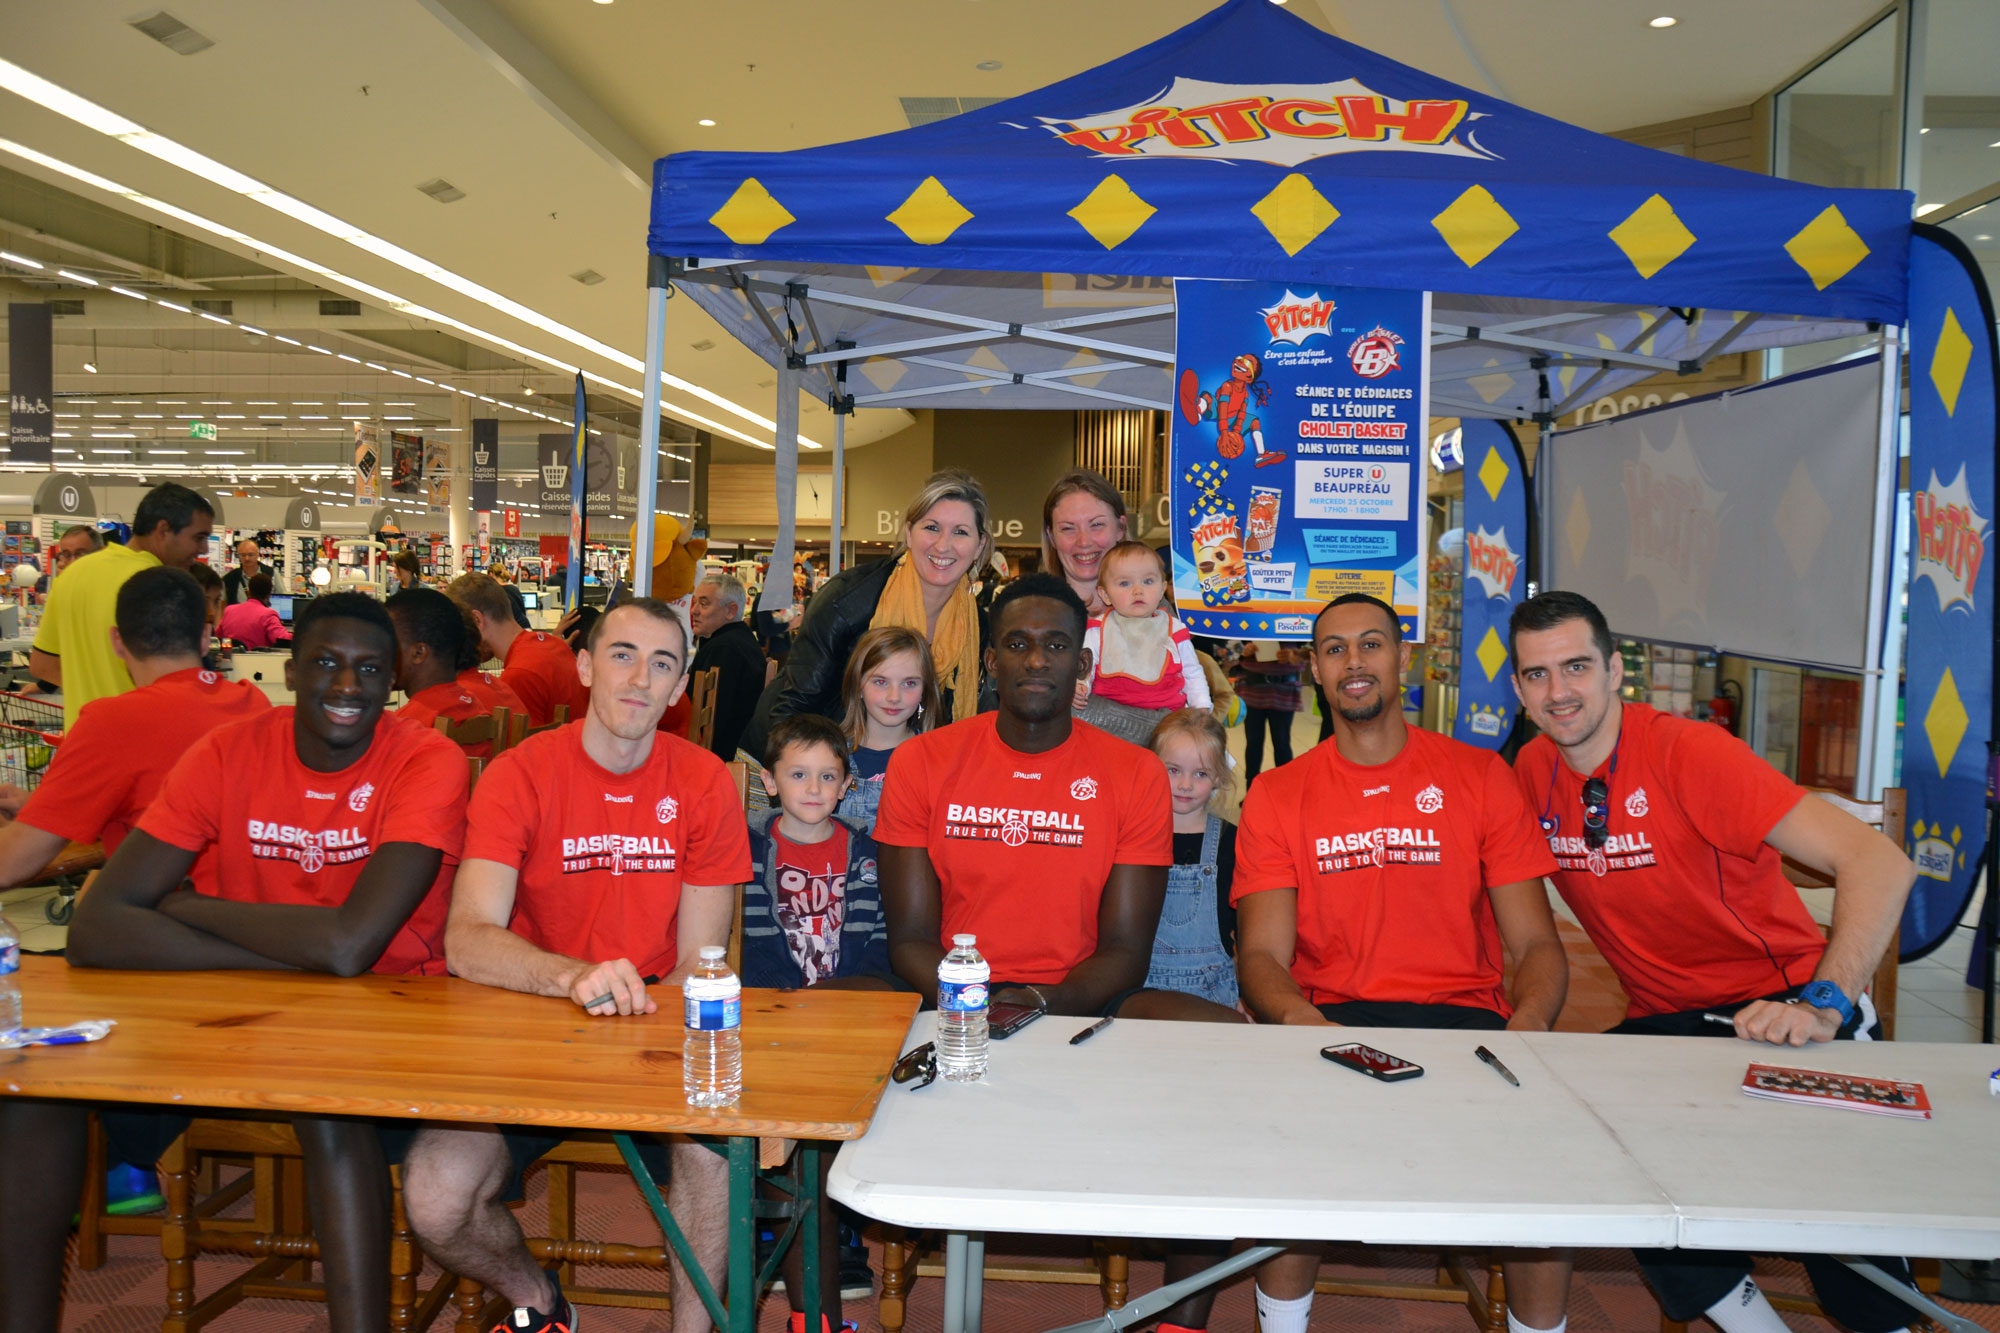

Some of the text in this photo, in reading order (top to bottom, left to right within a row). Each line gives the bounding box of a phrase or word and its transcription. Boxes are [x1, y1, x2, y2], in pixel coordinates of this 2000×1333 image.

[1297, 348, 1326, 358] enfant
[1278, 356, 1333, 366] c'est du sport
[1296, 384, 1412, 399] SÉANCE DE DÉDICACES
[1311, 401, 1396, 418] DE L'ÉQUIPE
[12, 426, 34, 434] Caisse
[1300, 422, 1406, 438] CHOLET BASKET
[12, 434, 51, 444] prioritaire
[1297, 443, 1324, 454] DANS
[1326, 444, 1359, 454] VOTRE
[1362, 444, 1404, 455] MAGASIN
[474, 472, 496, 480] rapides
[1324, 467, 1364, 478] SUPER
[1314, 480, 1390, 494] BEAUPRÉAU
[1360, 498, 1393, 506] OCTOBRE
[1314, 534, 1339, 542] SÉANCE
[1278, 622, 1309, 631] Pasquier
[1013, 771, 1042, 780] SPALDING
[947, 803, 1084, 830] BASKETBALL
[946, 825, 1084, 845] TRUE TO THE GAME
[285, 848, 300, 860] TO
[339, 846, 371, 862] GAME
[563, 857, 676, 872] TRUE TO THE GAME
[1318, 850, 1440, 872] TRUE TO THE GAME
[1608, 857, 1625, 869] THE
[1627, 854, 1656, 867] GAME
